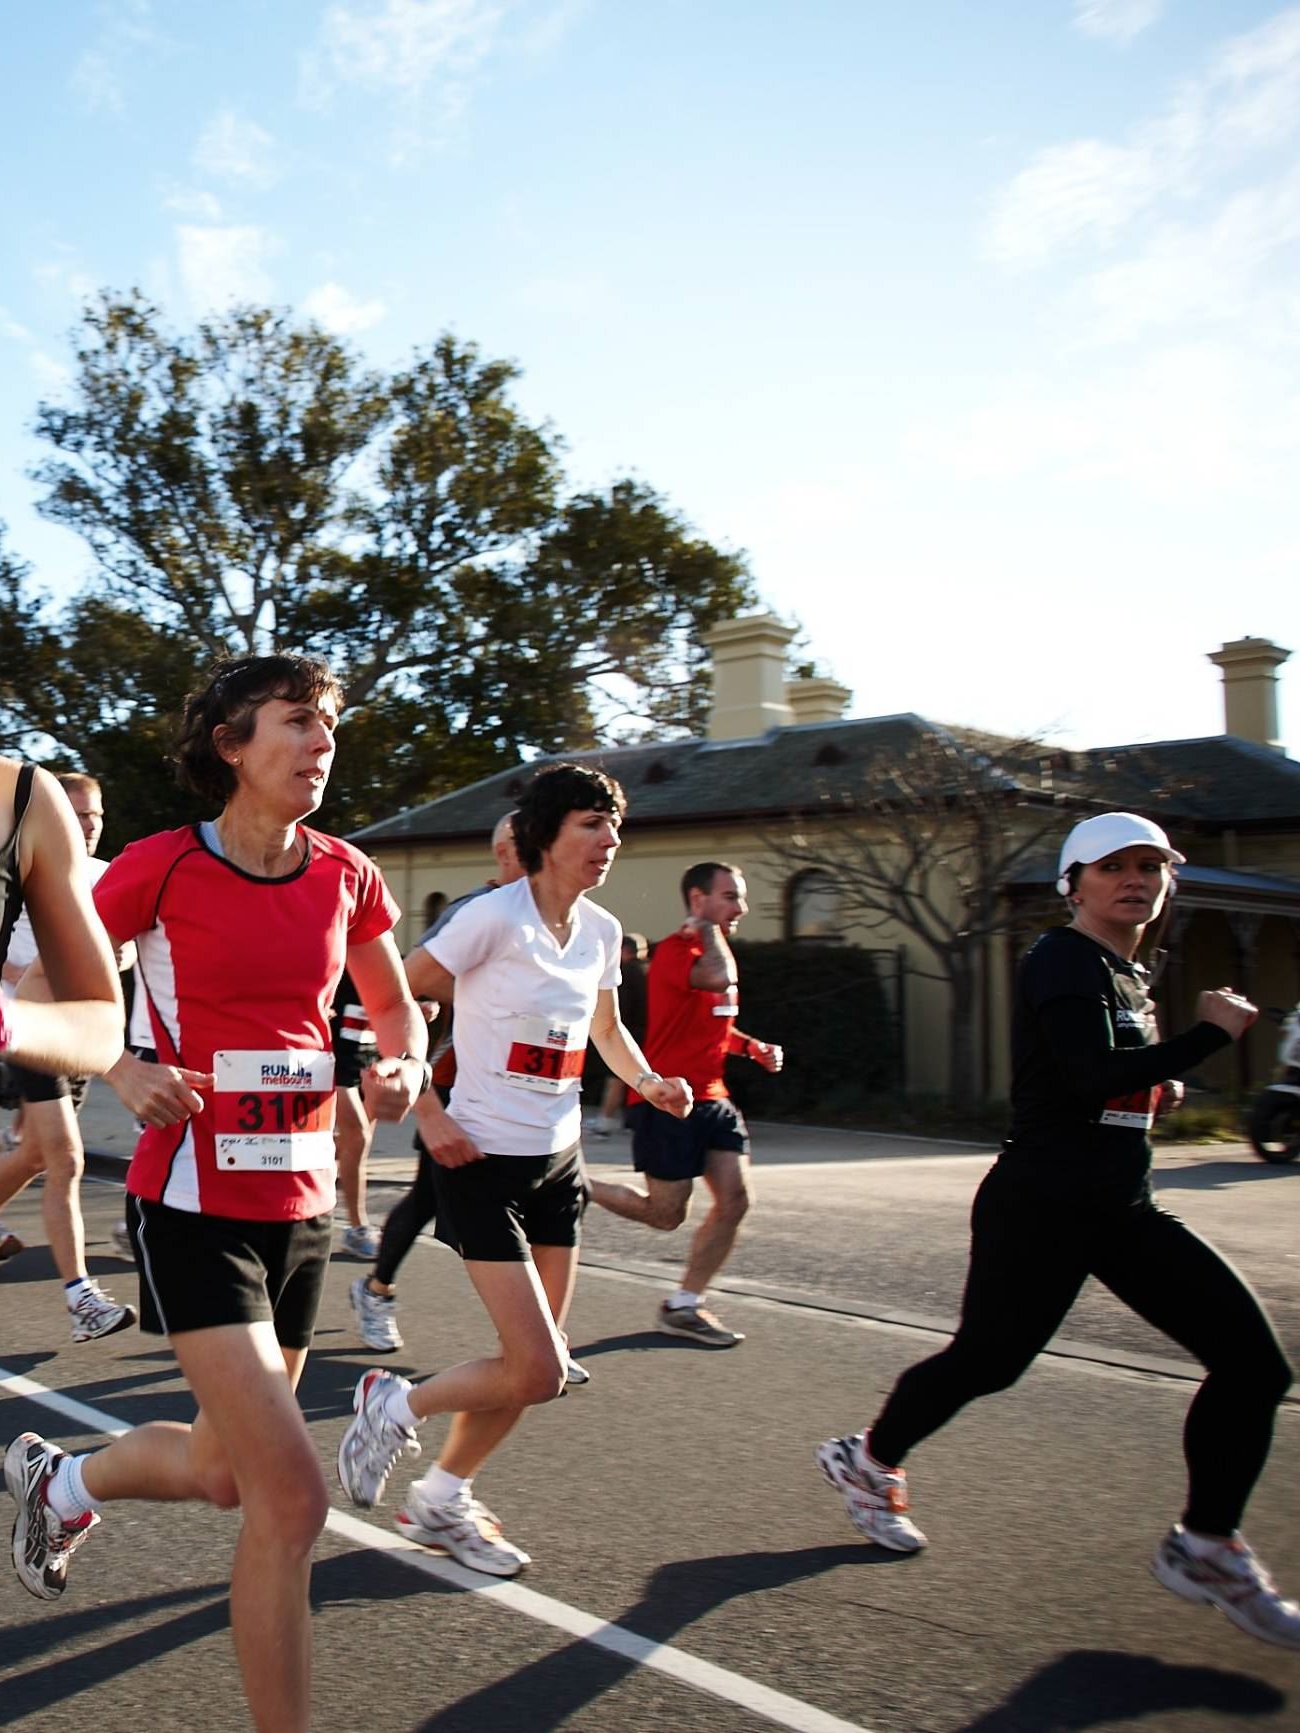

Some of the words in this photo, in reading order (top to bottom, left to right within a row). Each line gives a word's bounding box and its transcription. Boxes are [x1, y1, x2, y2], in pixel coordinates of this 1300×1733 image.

[261, 1064, 290, 1076] RUN
[238, 1093, 320, 1131] 3101
[261, 1156, 283, 1165] 3101
